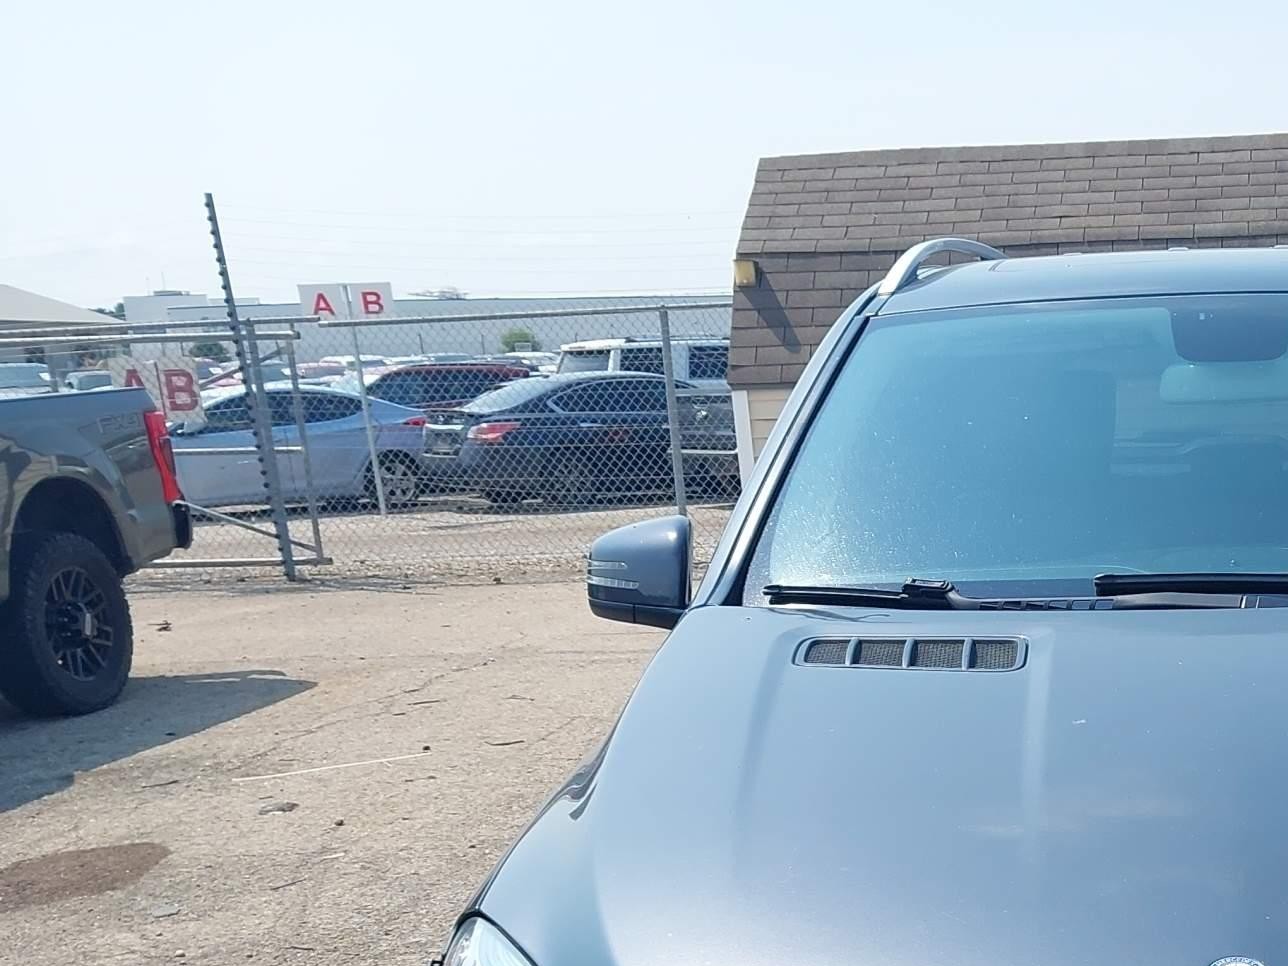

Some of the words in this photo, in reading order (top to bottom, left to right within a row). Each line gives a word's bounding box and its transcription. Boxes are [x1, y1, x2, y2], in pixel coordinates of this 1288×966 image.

[313, 293, 335, 315] A
[361, 292, 384, 314] B
[163, 369, 199, 411] B
